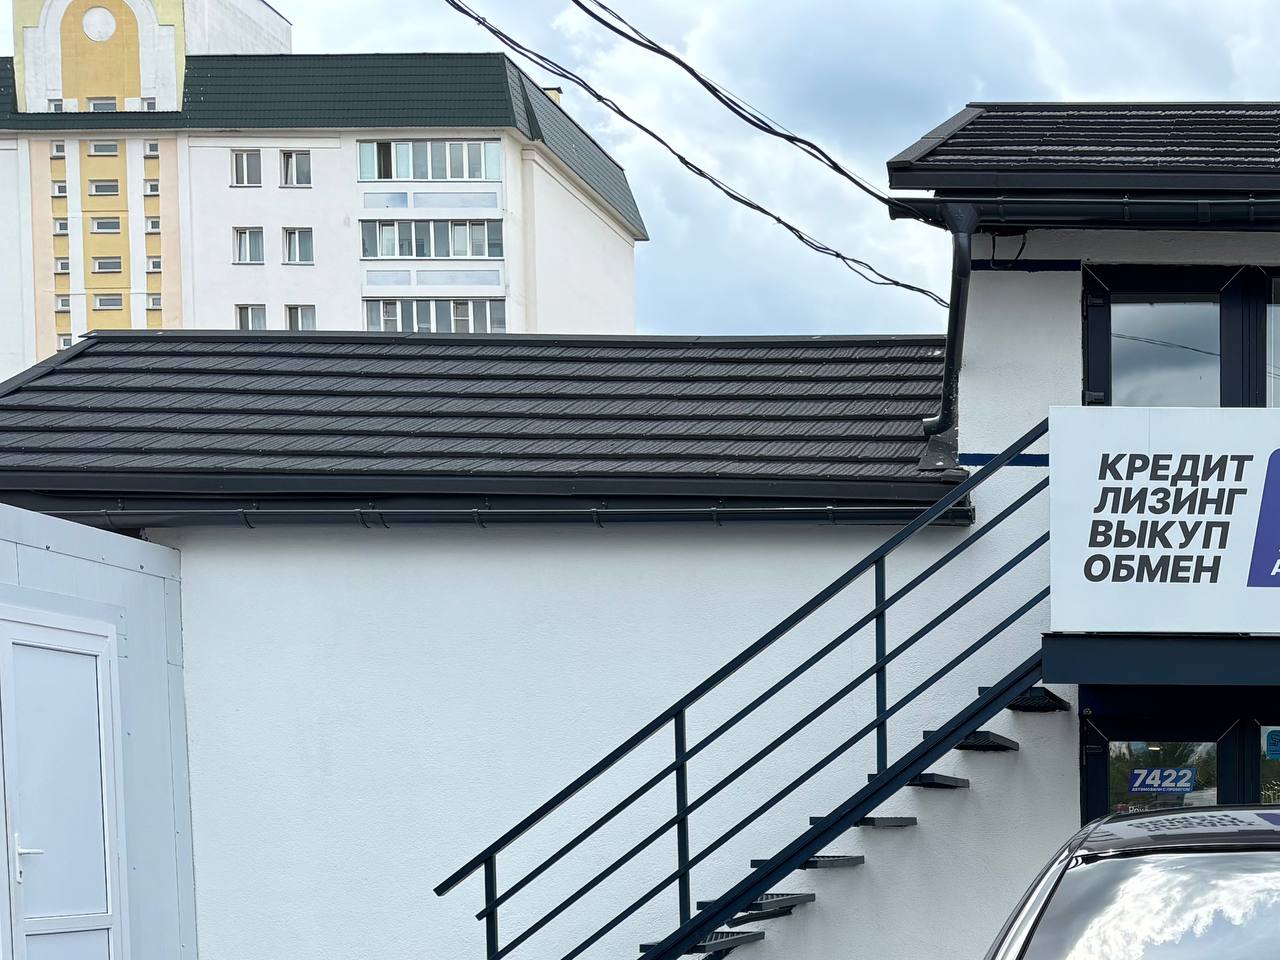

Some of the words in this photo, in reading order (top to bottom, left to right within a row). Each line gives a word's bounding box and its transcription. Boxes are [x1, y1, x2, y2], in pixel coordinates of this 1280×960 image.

[1098, 453, 1253, 487] КРЕДИТ
[1093, 487, 1247, 515] ЛИЗИНГ
[1088, 520, 1230, 549] ВЫКУП
[1083, 554, 1221, 584] ОБМЕН
[1133, 769, 1192, 787] 7422
